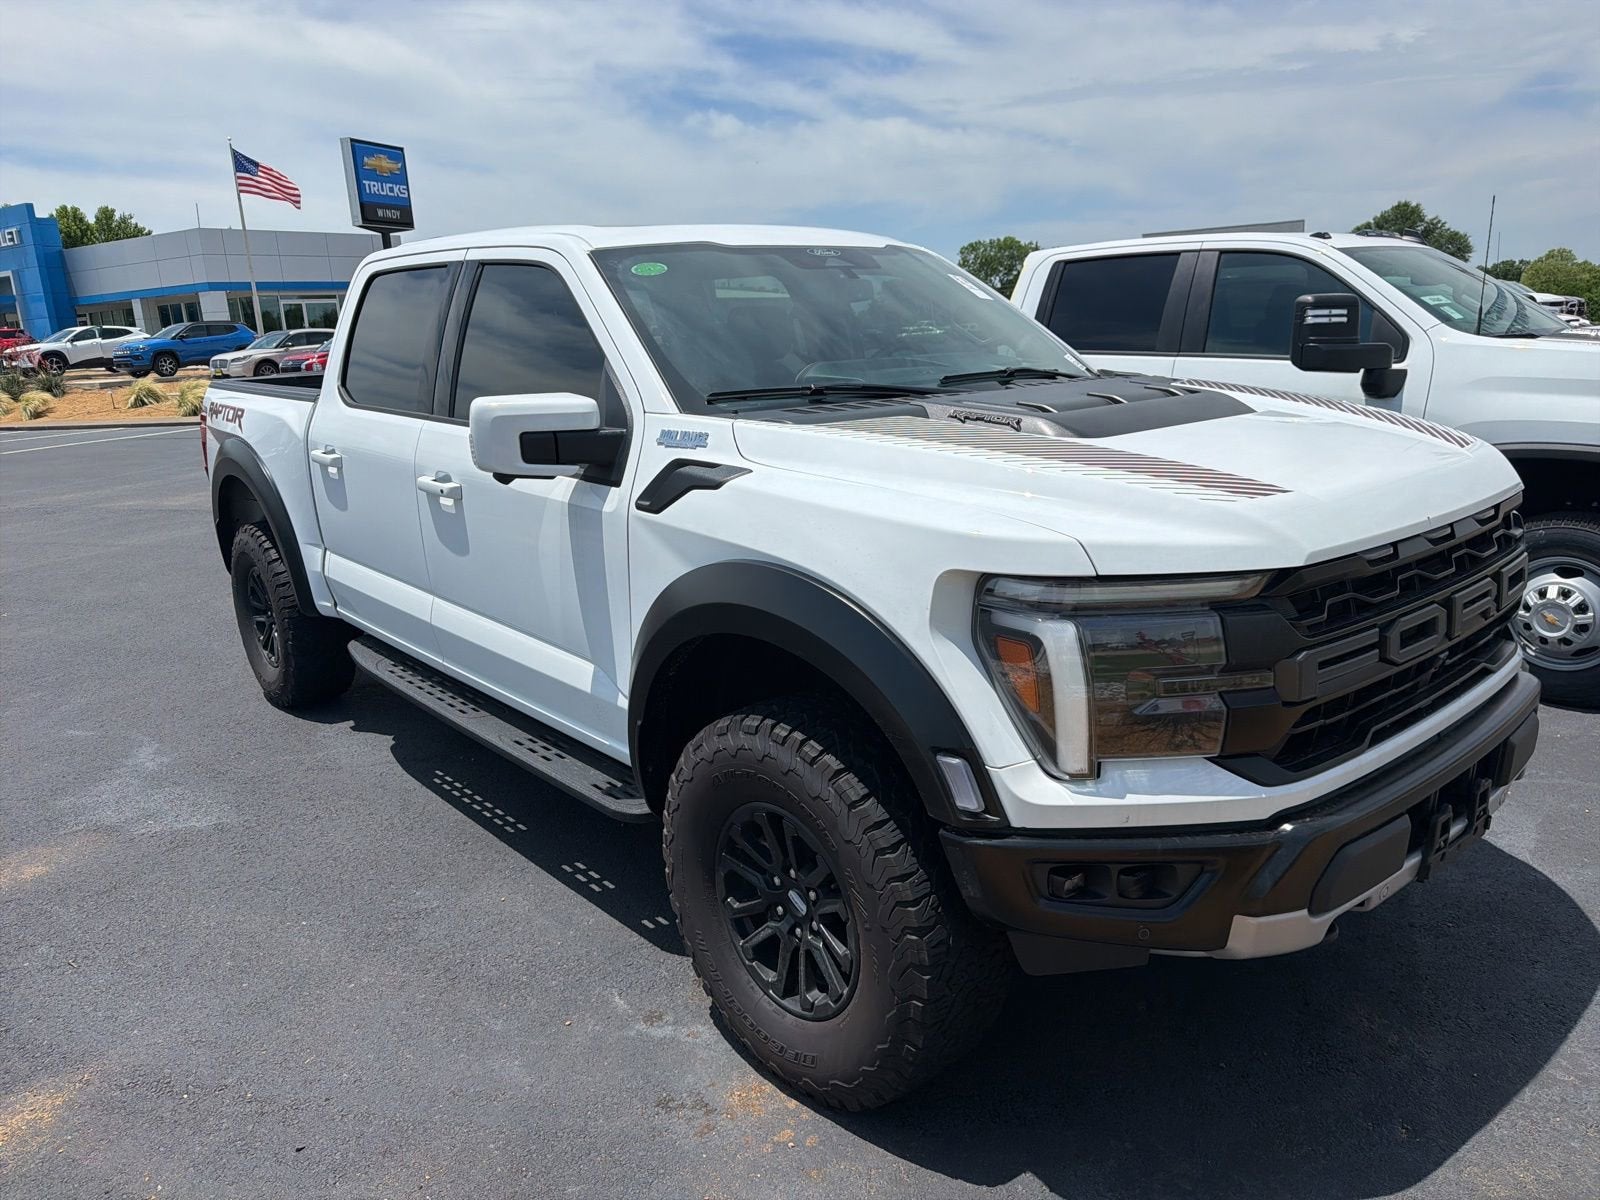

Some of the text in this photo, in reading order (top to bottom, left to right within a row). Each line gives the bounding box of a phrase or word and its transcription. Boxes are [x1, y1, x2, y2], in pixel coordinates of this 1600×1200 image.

[363, 180, 408, 198] TRUCKS
[377, 207, 400, 220] WINDY
[208, 401, 245, 434] RAPTOR
[948, 409, 1022, 432] RAPTOR
[1276, 552, 1528, 701] FORD
